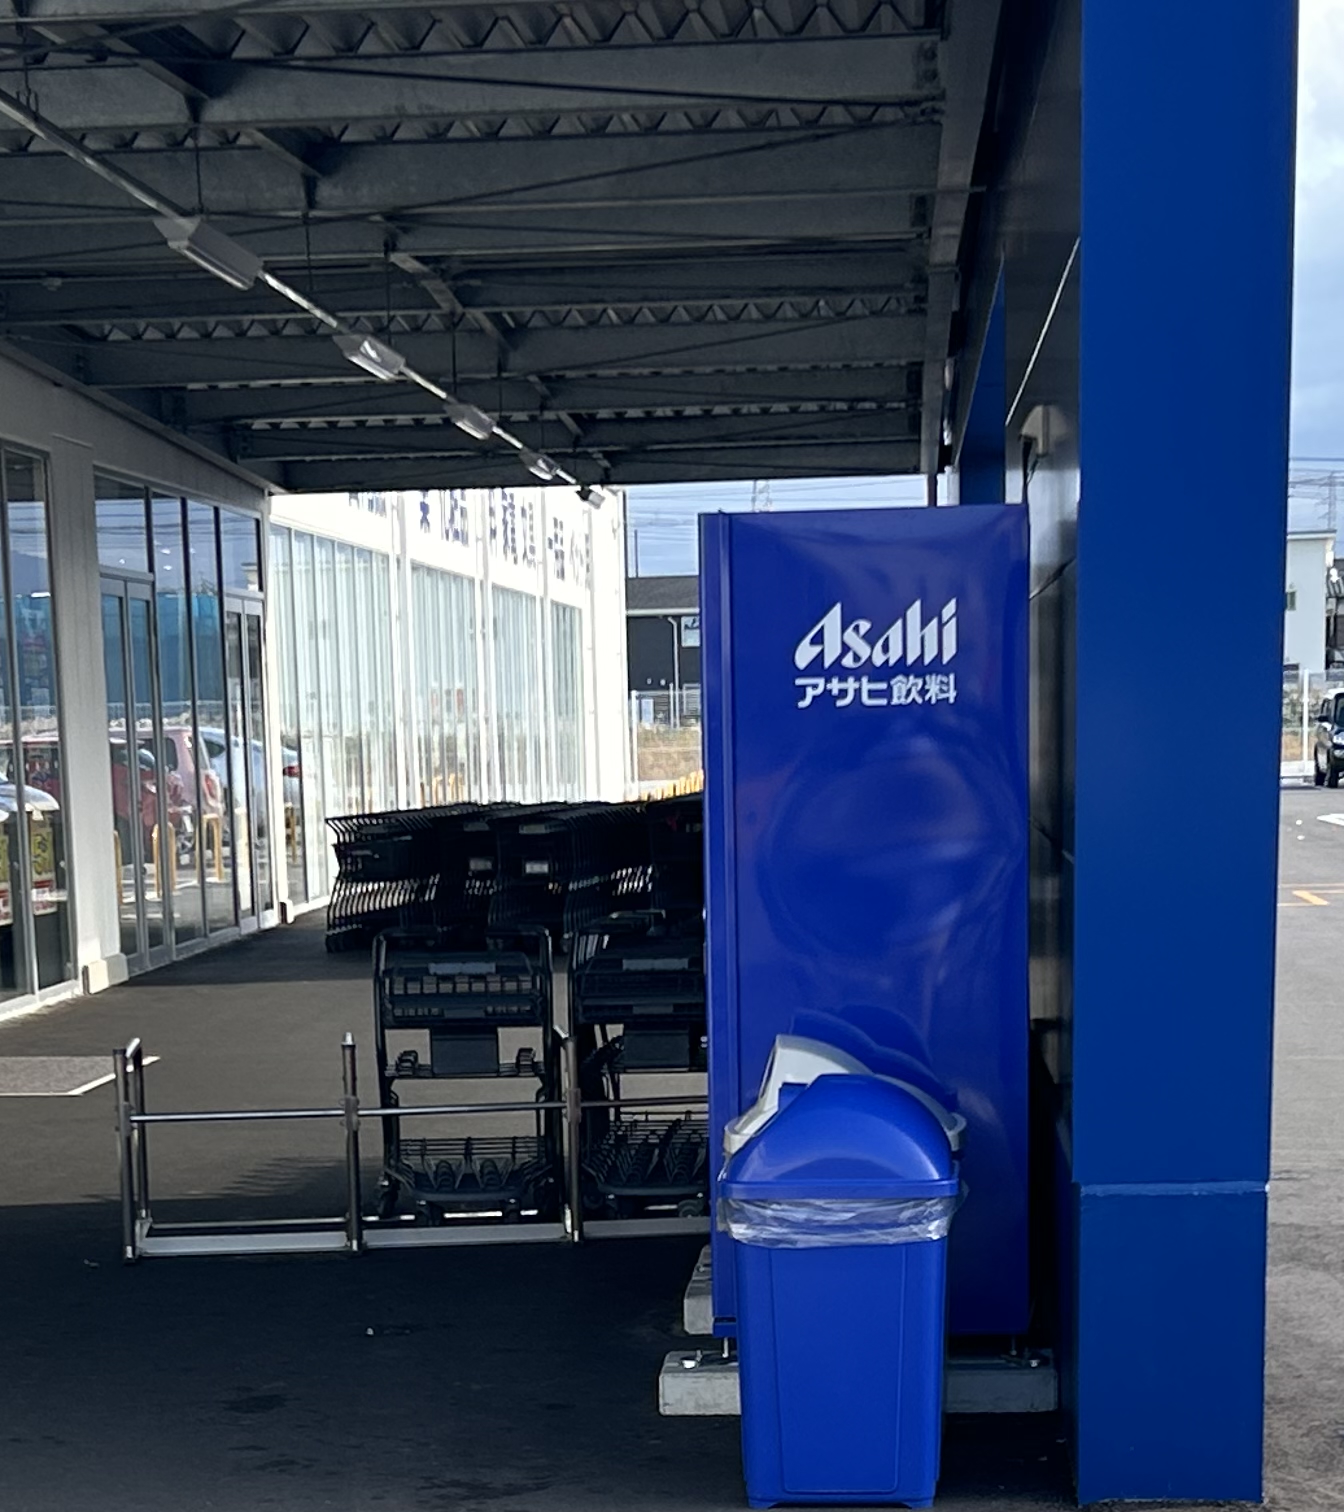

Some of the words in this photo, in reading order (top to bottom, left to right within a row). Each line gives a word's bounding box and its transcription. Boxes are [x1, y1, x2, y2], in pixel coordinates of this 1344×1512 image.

[794, 597, 957, 671] Asahi
[795, 673, 956, 709] アサヒ飲料
